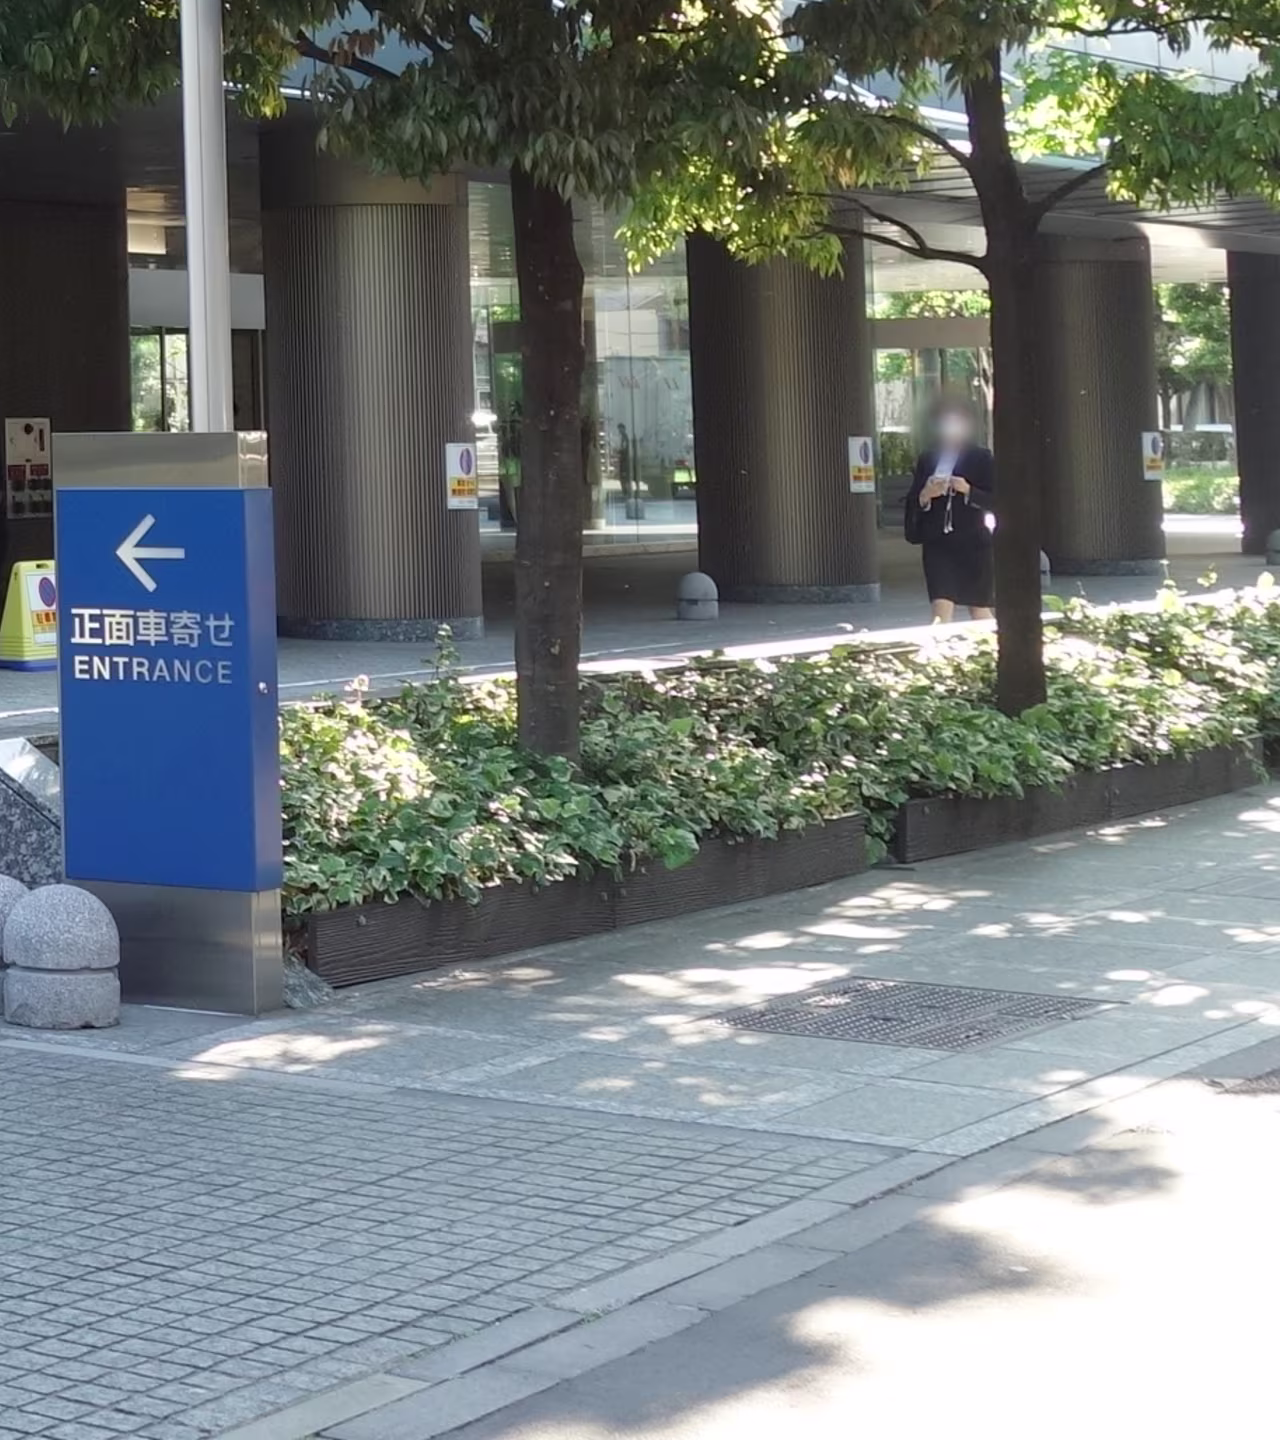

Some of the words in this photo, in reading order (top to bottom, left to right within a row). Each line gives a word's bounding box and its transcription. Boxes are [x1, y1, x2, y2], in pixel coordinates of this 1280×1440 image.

[71, 608, 235, 648] 正面車寄せ
[74, 655, 232, 684] ENTRANCE
